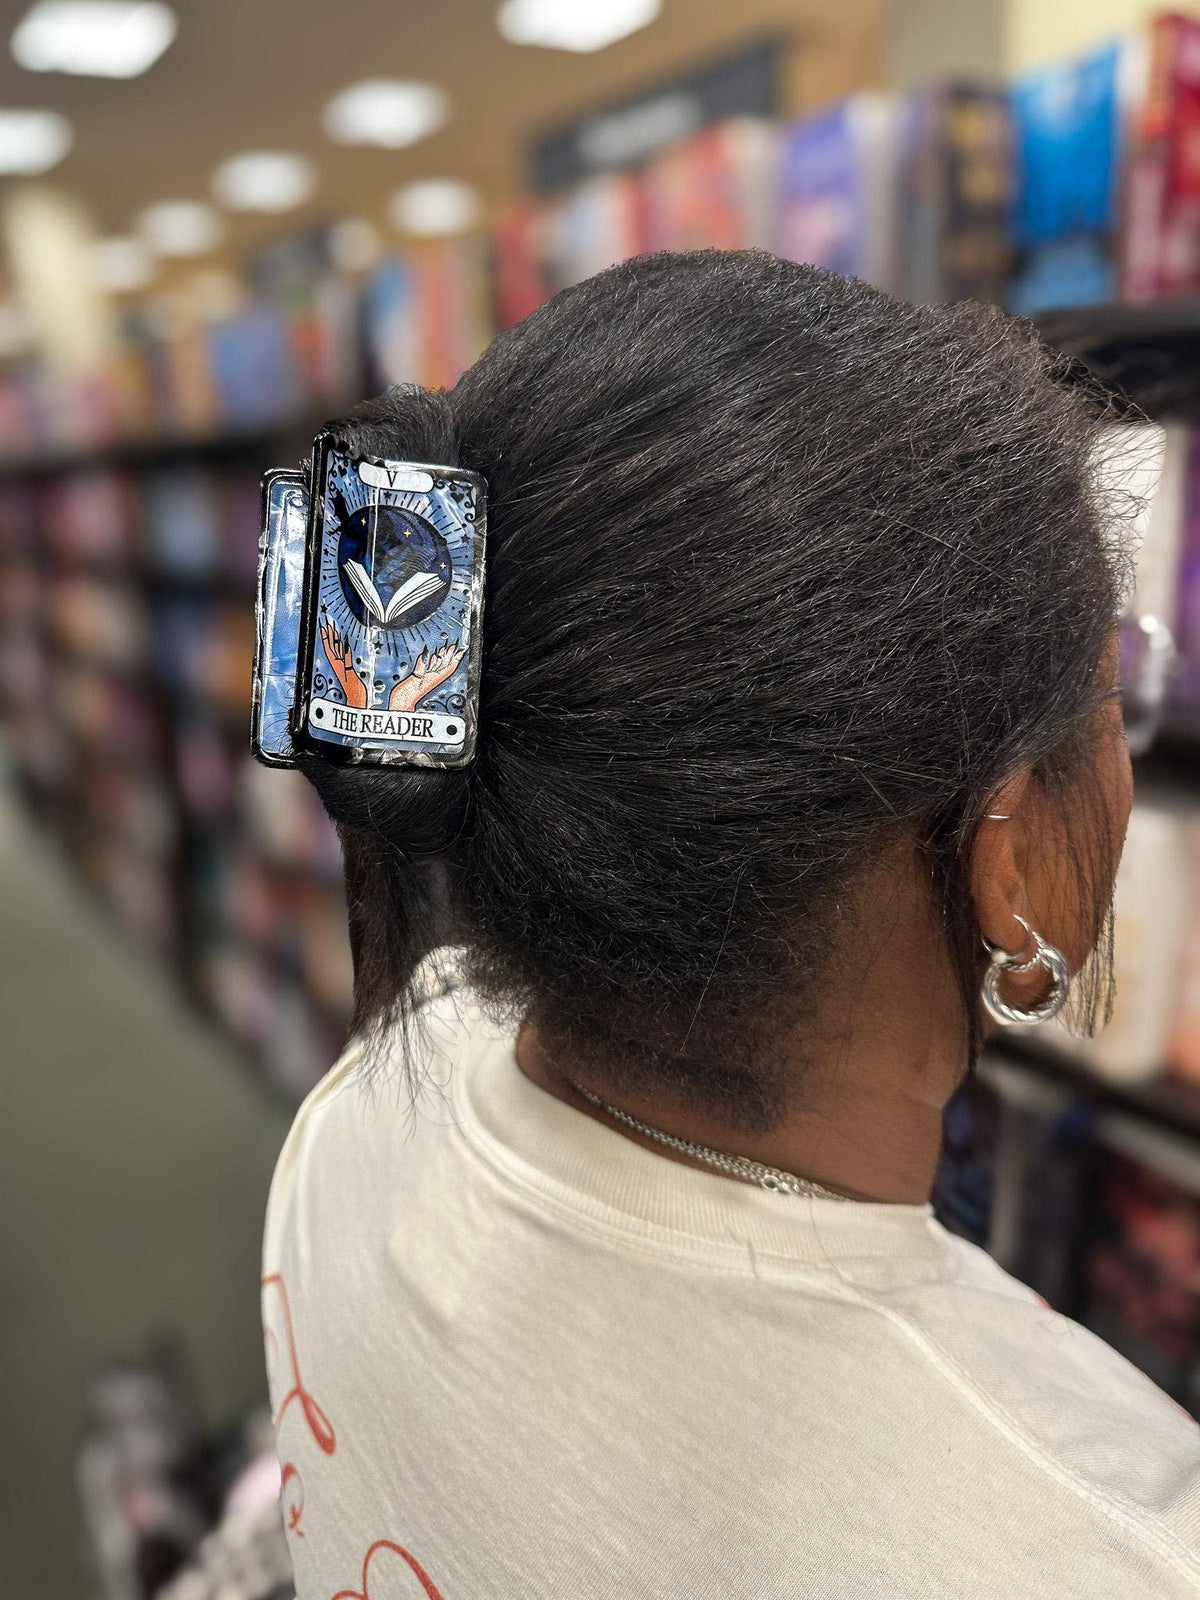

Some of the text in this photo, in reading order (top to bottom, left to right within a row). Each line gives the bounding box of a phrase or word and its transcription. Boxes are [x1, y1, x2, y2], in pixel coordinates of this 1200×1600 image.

[386, 470, 398, 488] V
[333, 708, 434, 738] THE READER
